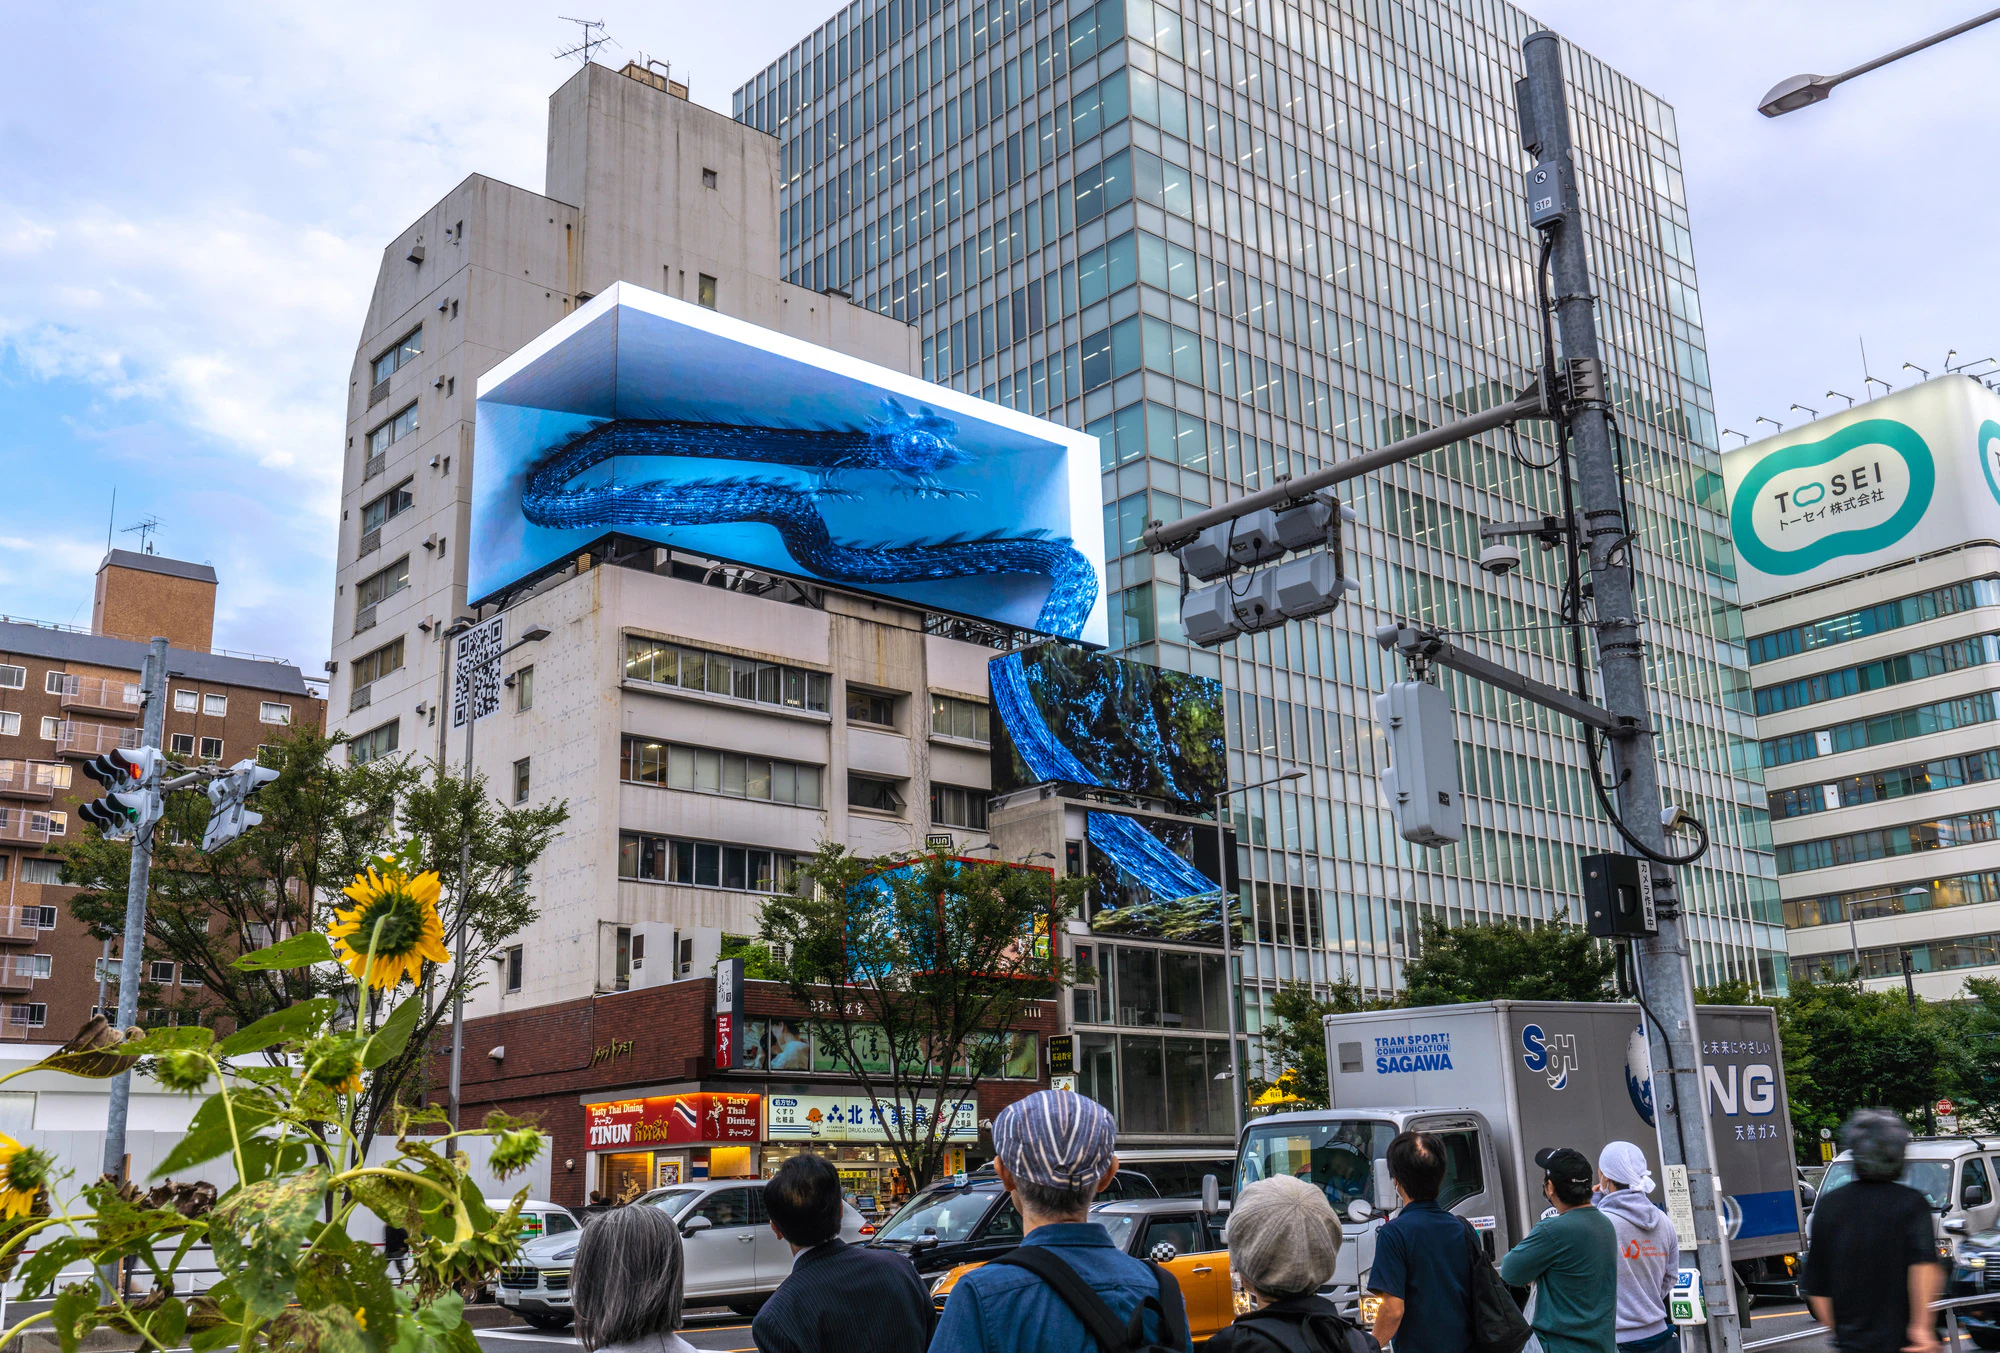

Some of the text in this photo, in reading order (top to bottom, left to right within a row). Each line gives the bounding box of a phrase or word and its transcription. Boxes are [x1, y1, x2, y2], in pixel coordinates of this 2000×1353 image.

[1535, 199, 1551, 211] 31P
[1774, 462, 1882, 514] TOSEI
[1641, 863, 1654, 929] カメラ作動中
[1377, 1044, 1449, 1056] COMMUNICATION
[1376, 1053, 1453, 1074] SAGAWA
[727, 1096, 749, 1106] Tasty
[591, 1103, 644, 1117] Tasty Thai Dining
[727, 1106, 746, 1115] Thai
[726, 1116, 756, 1126] Dining
[589, 1123, 632, 1146] TINUN
[1735, 1124, 1778, 1141] 天然ガス
